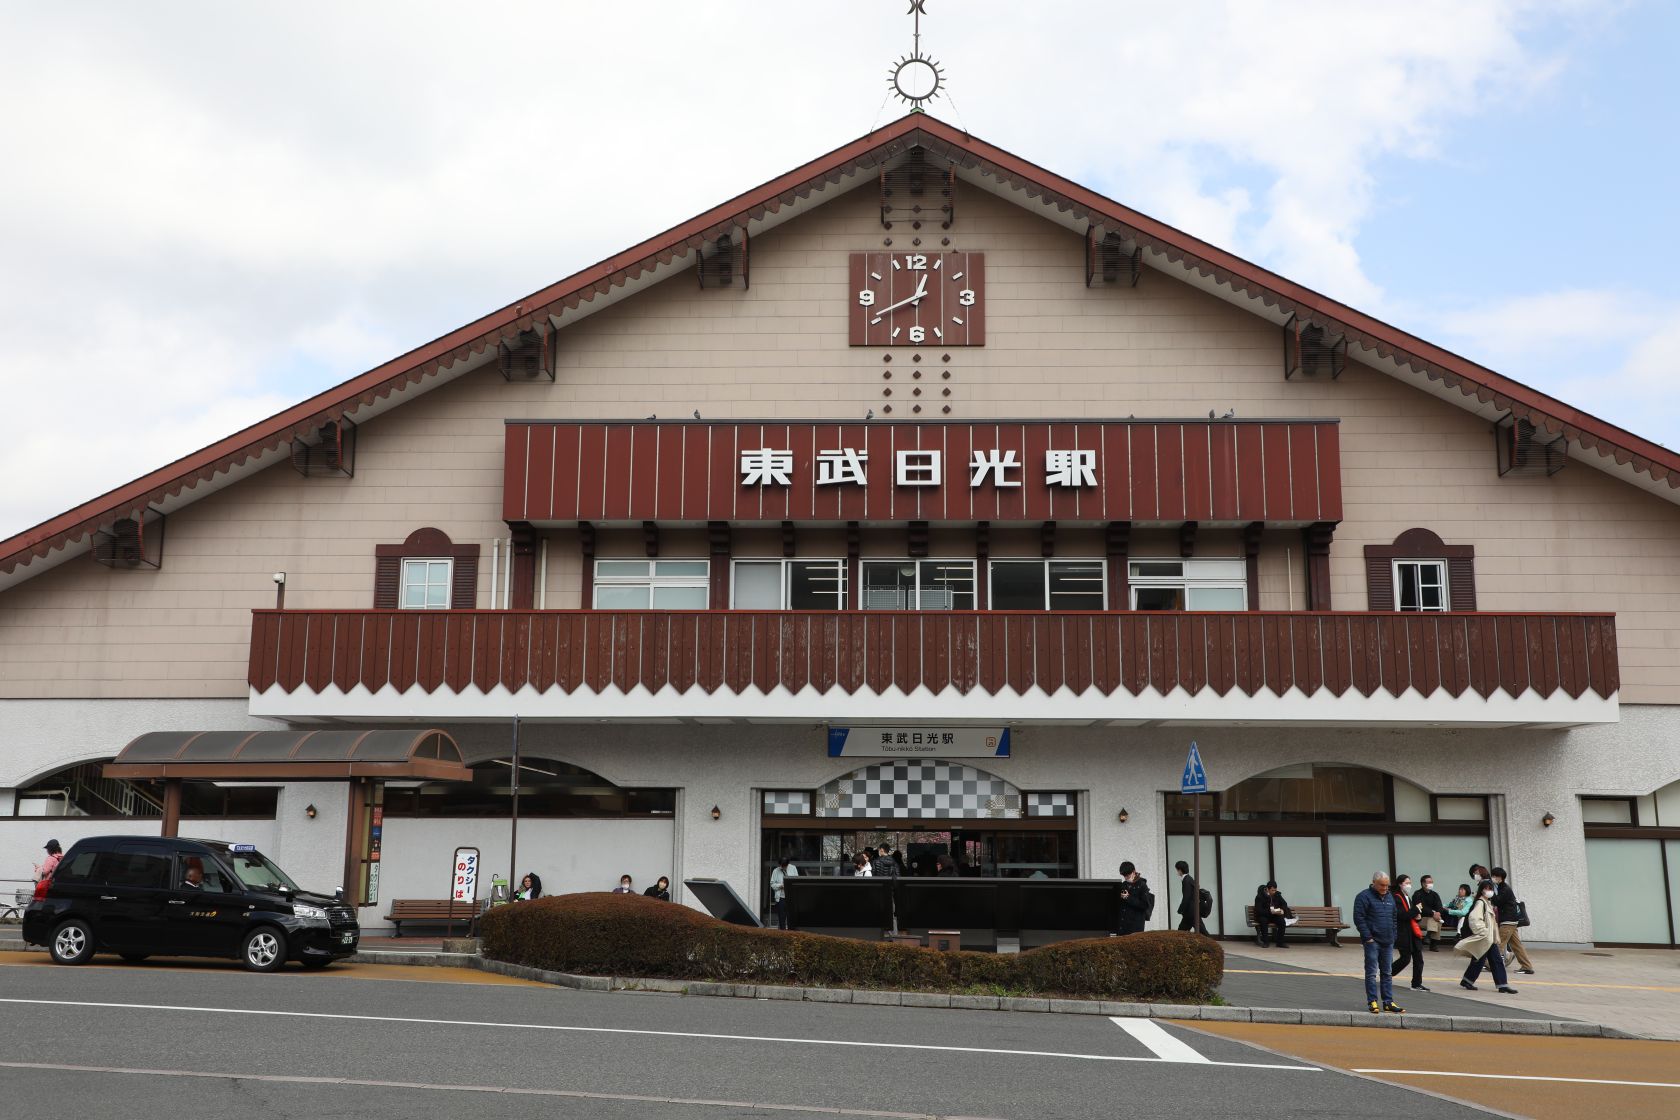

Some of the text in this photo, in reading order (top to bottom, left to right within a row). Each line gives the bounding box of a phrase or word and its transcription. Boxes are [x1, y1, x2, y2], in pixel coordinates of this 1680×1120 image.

[905, 255, 927, 270] 12
[859, 289, 875, 306] 9
[959, 289, 975, 306] 3
[909, 325, 925, 343] 6
[741, 448, 1099, 487] 東武日光駅
[881, 732, 954, 745] 東武日光駅
[455, 862, 466, 899] のりば
[465, 856, 475, 894] タクシー
